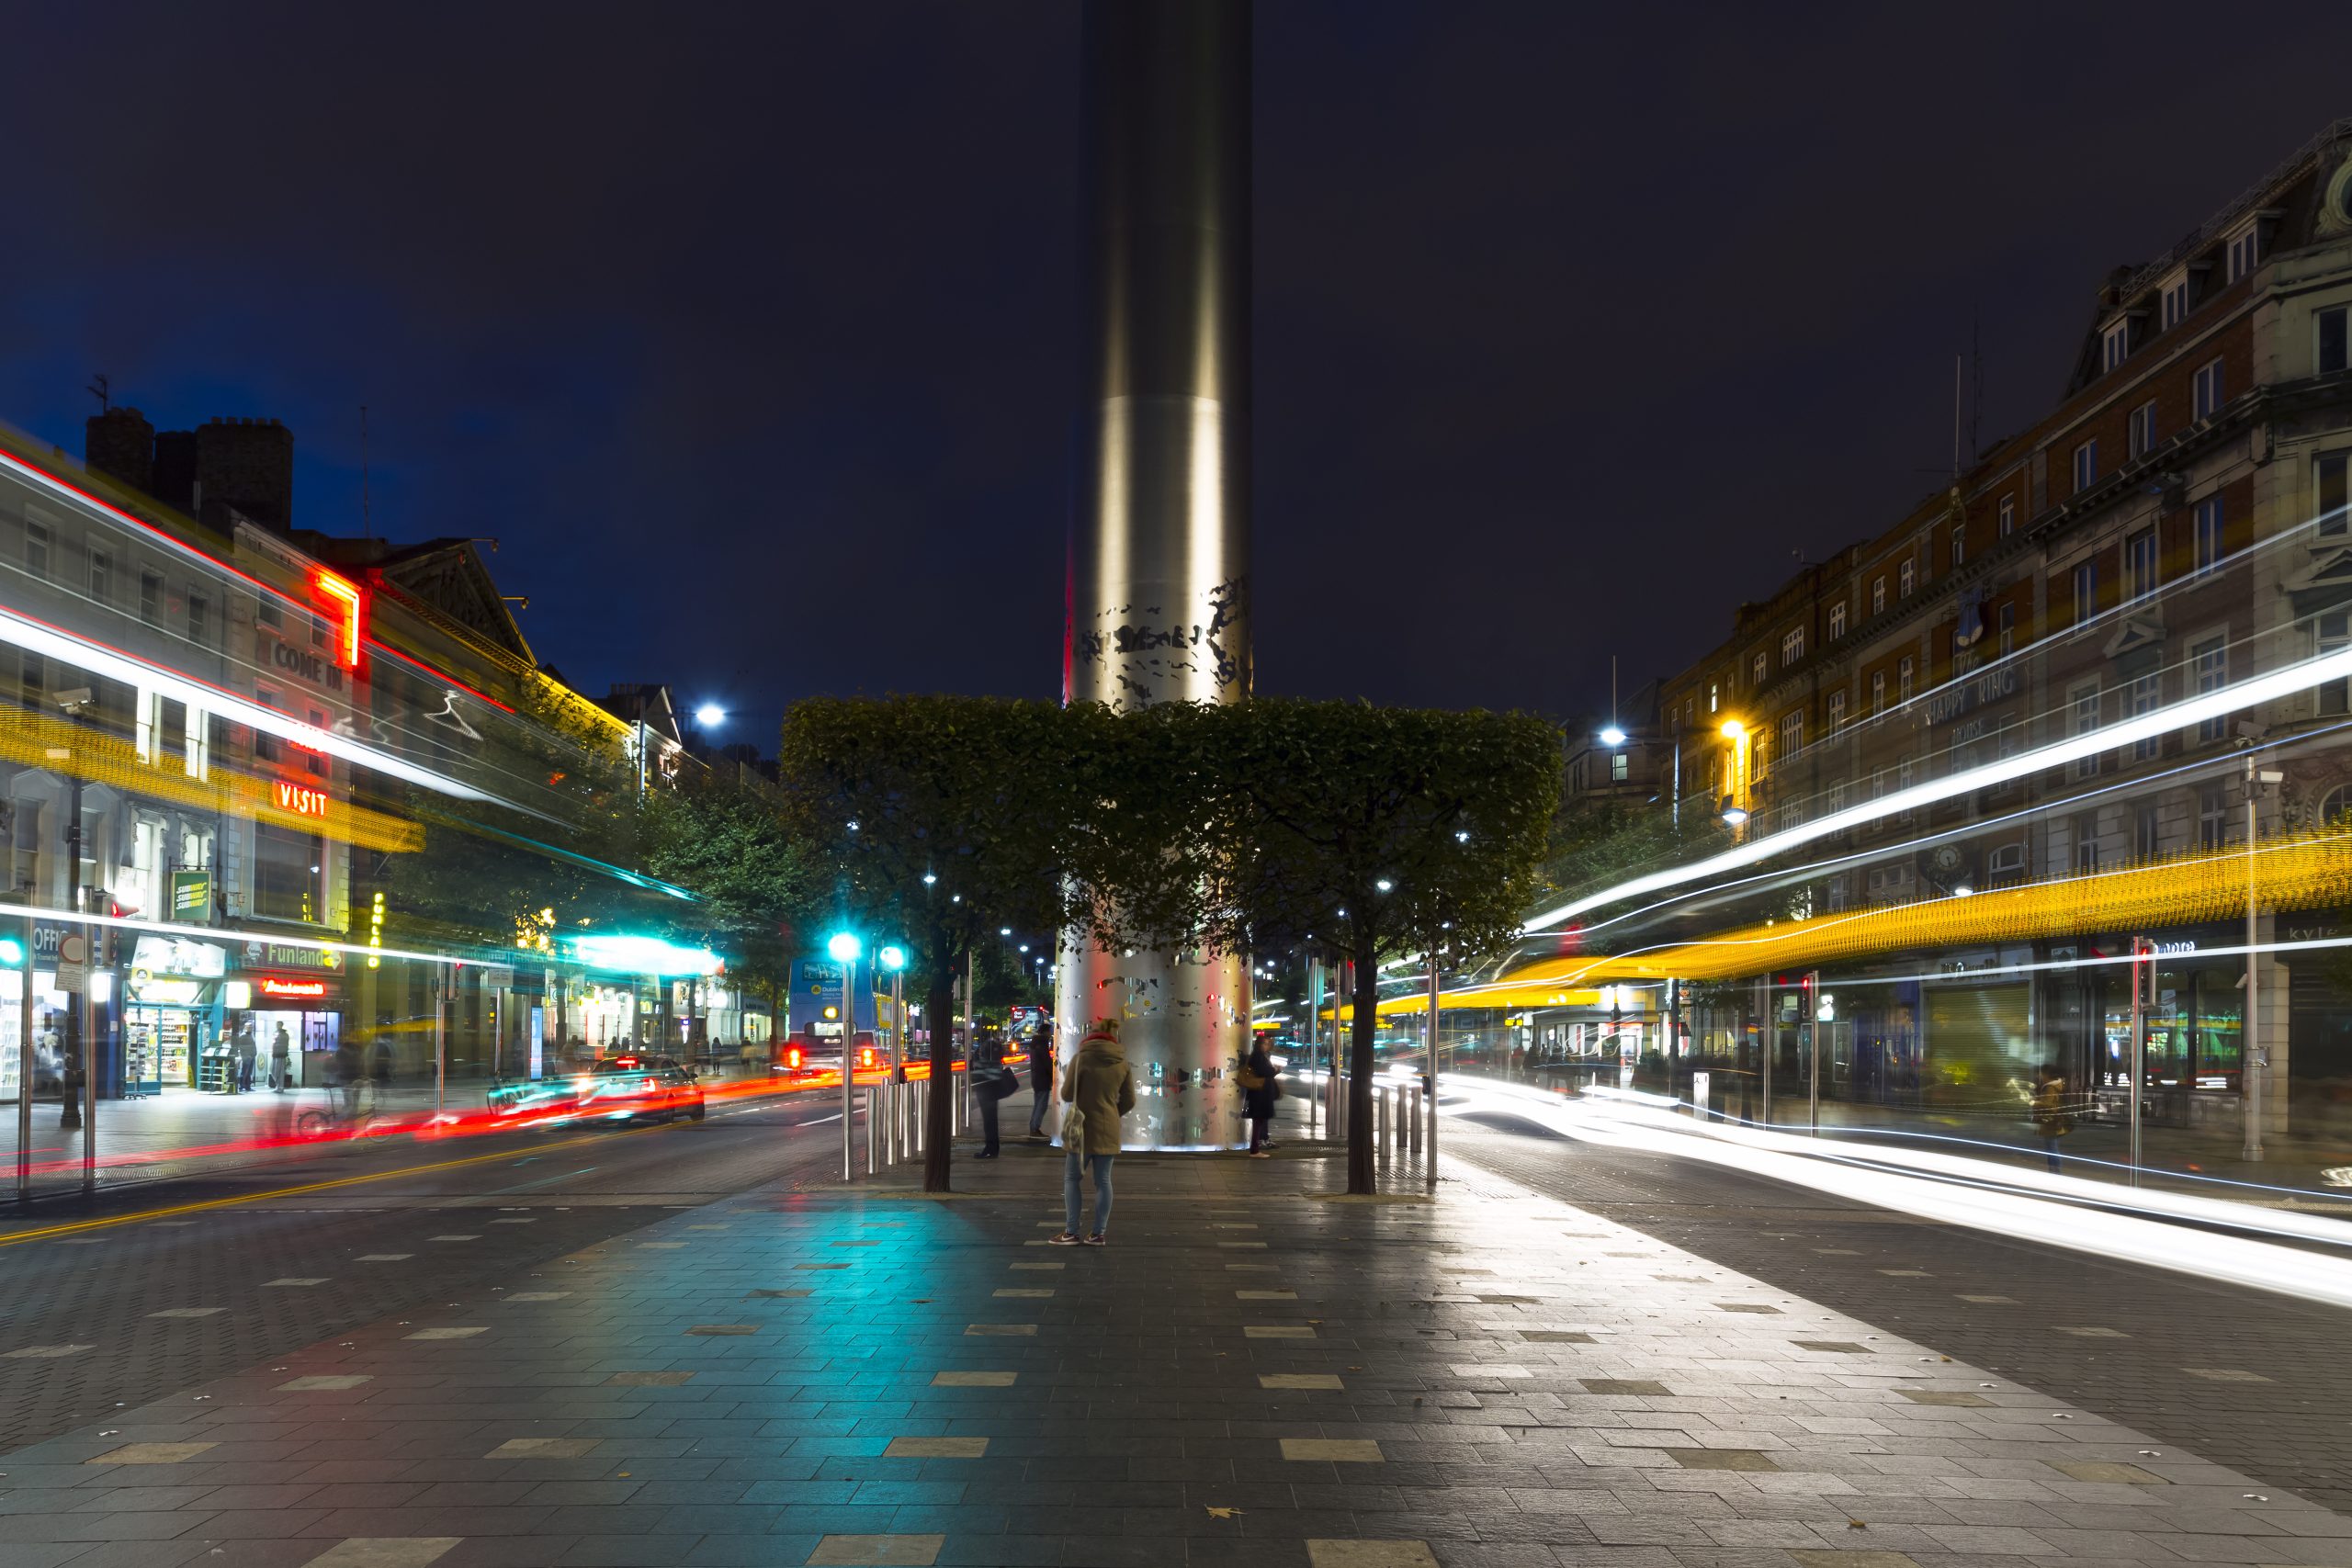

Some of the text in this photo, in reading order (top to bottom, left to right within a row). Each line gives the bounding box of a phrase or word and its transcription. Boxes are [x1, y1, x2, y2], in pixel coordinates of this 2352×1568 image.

[275, 643, 343, 691] COME IN
[1929, 668, 2015, 726] HAPPY RING
[280, 783, 327, 816] VISIT
[176, 882, 207, 894] SUBWAY
[176, 890, 207, 902] SUBWAY
[176, 898, 207, 910] SUBWAY
[368, 892, 384, 968] FUNLAD
[268, 942, 323, 966] Funland
